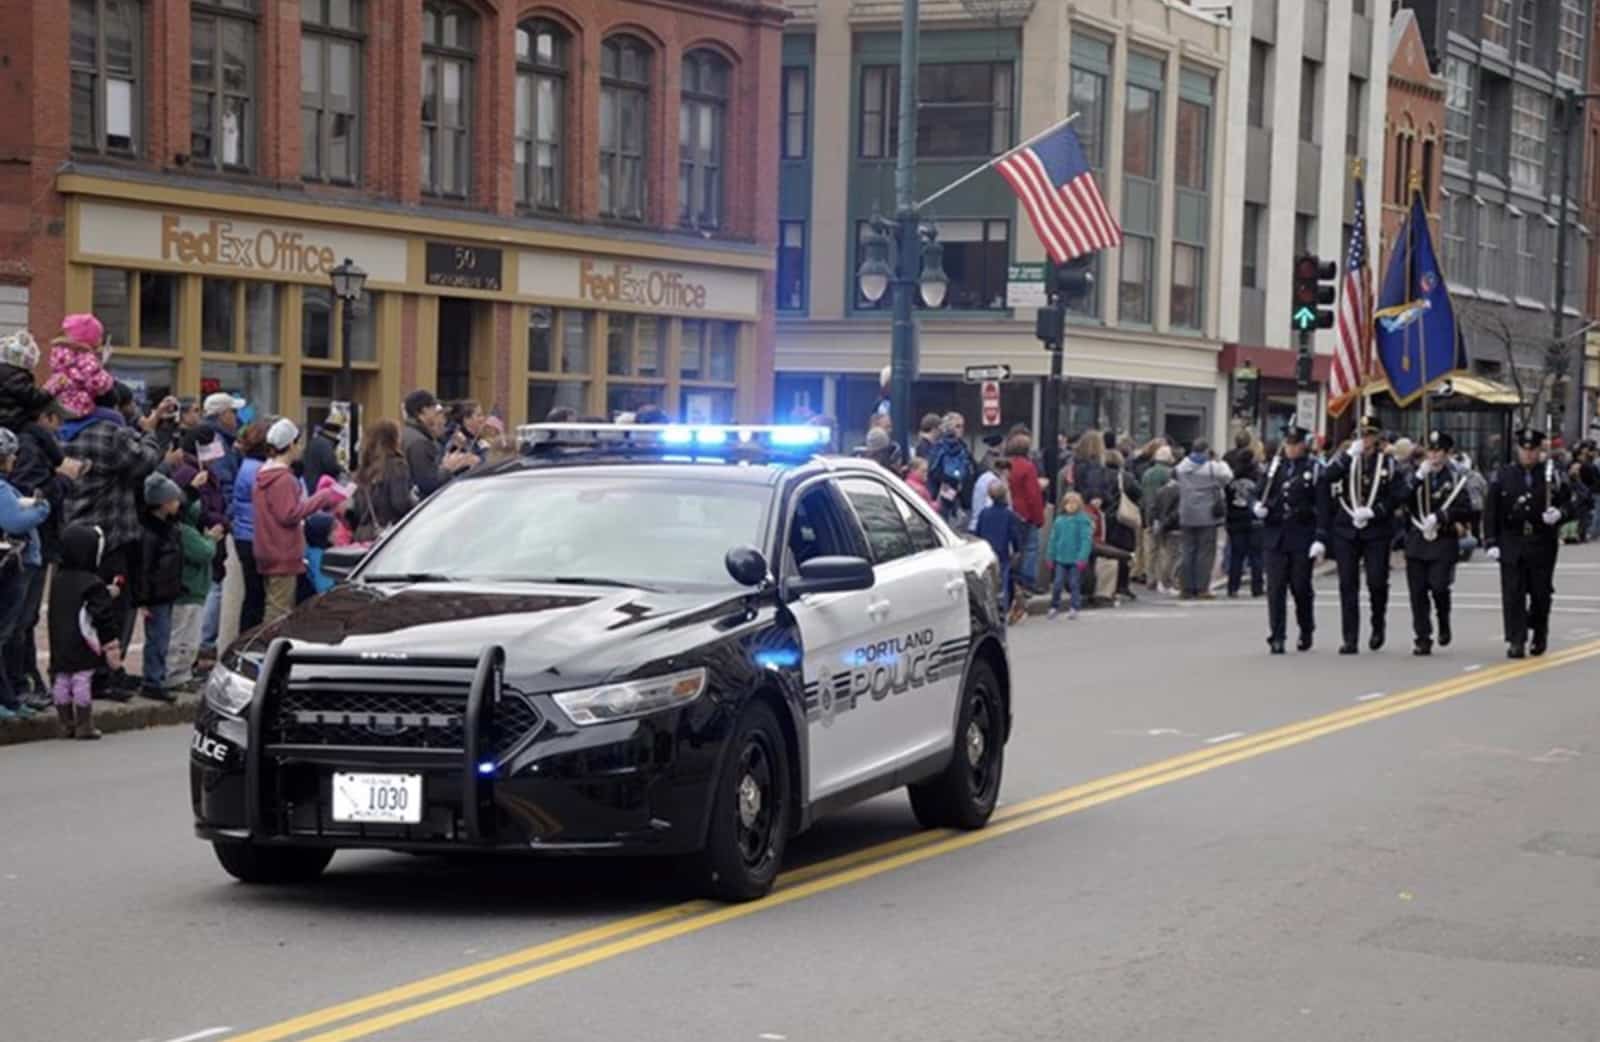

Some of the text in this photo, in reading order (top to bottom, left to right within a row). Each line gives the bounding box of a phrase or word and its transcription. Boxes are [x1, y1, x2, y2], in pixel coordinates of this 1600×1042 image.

[855, 628, 934, 667] PORTLAND
[849, 648, 945, 710] POLICE
[368, 786, 408, 810] 1030
